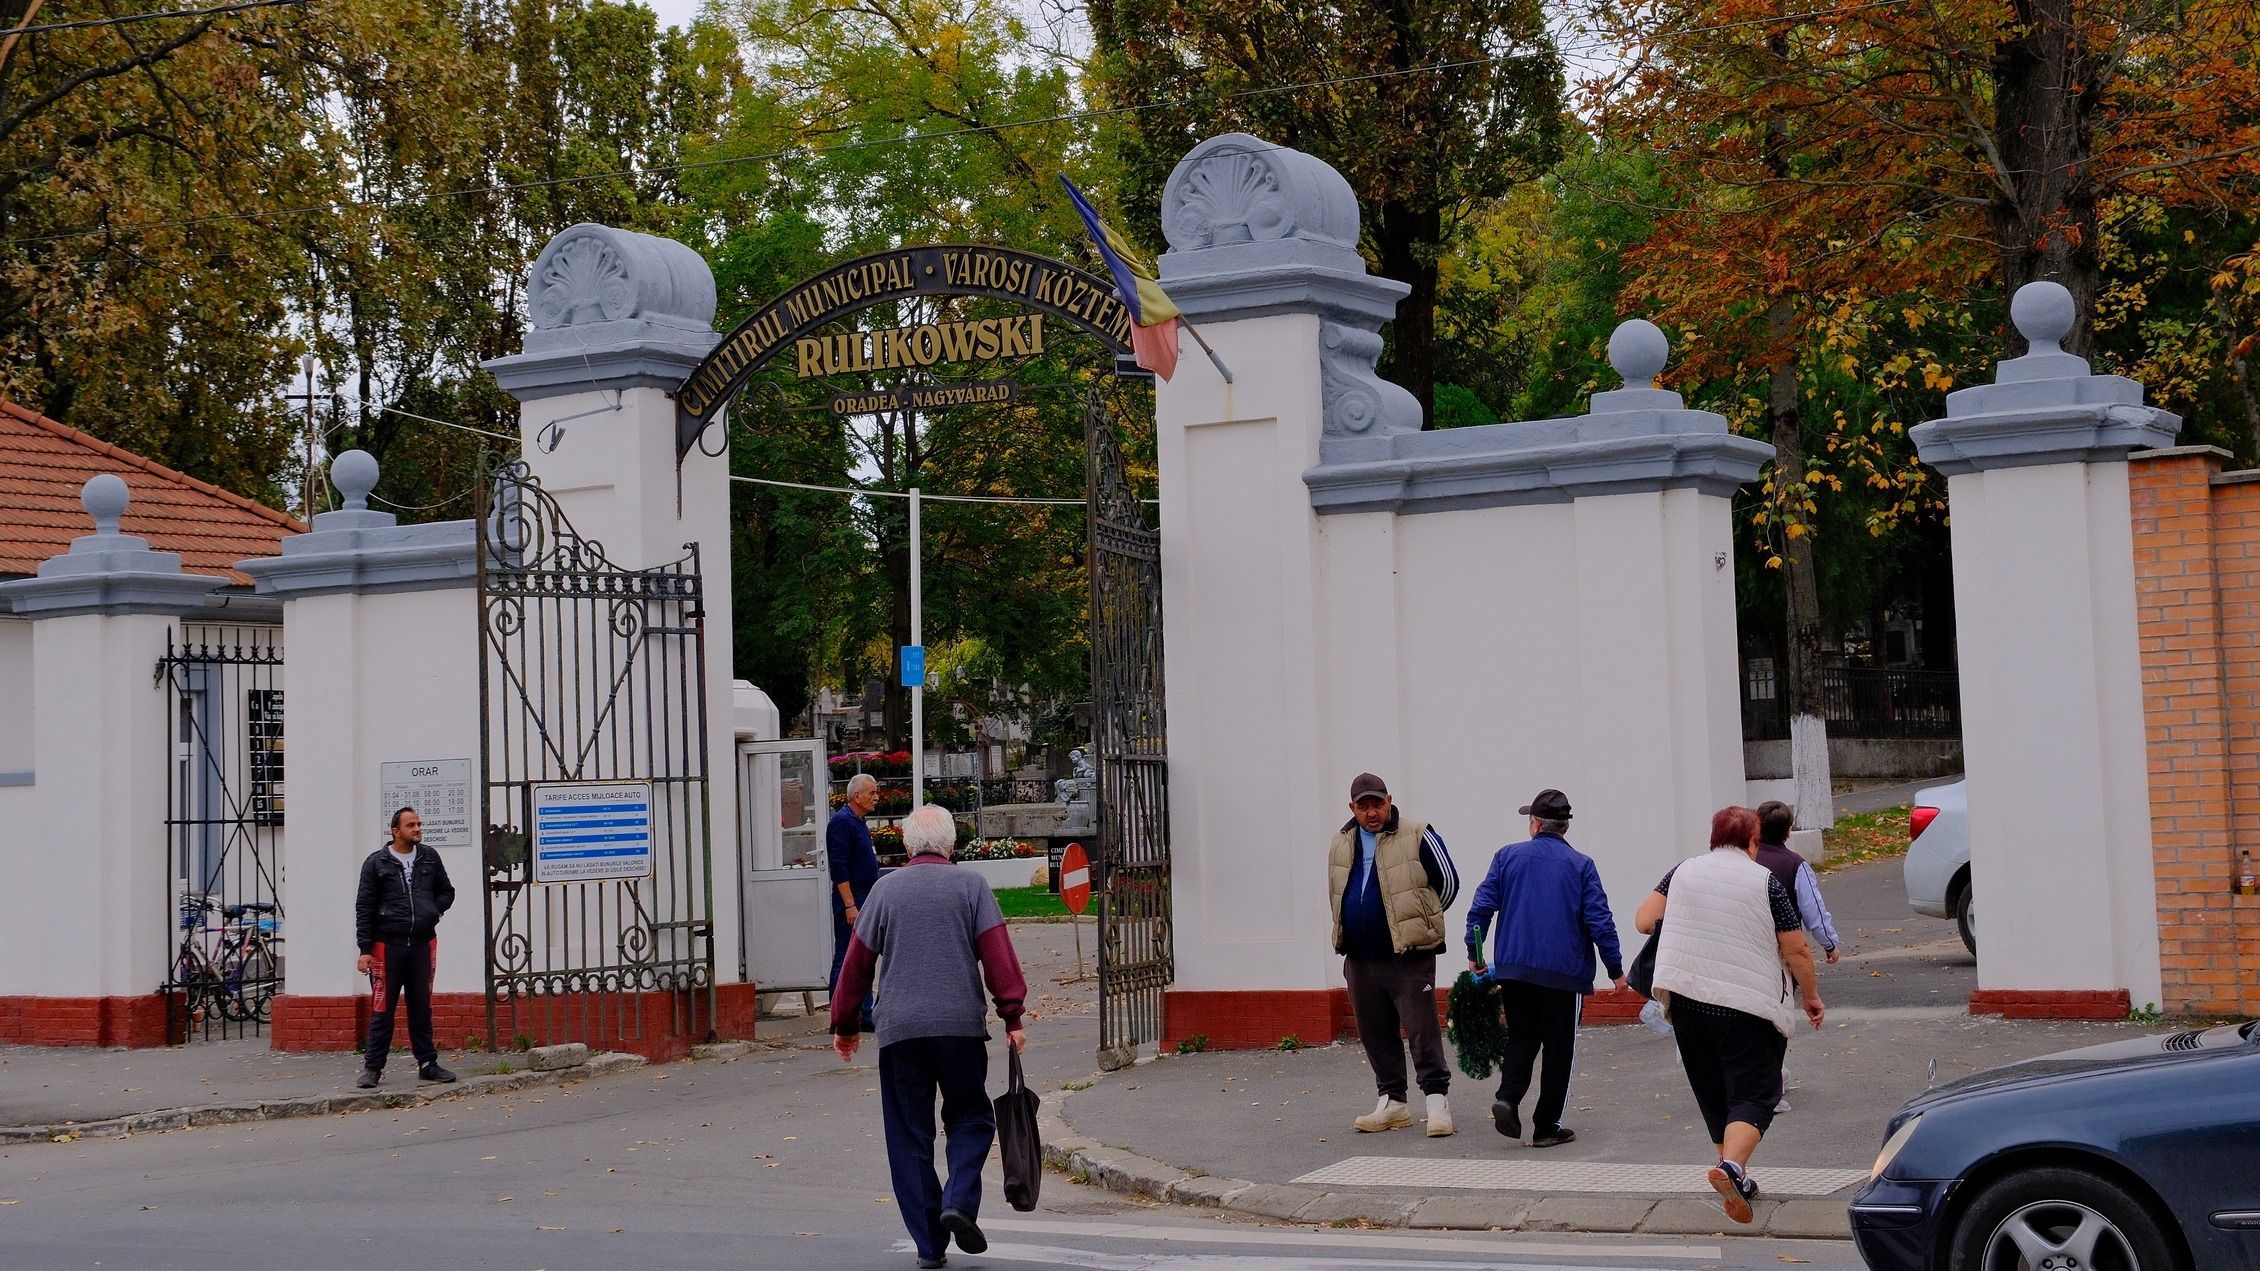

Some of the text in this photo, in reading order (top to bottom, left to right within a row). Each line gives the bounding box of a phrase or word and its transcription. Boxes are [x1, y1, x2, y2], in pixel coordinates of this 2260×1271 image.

[682, 248, 1132, 417] CIMITIRUL MUNICIPAL VÁROSI KÖZTEM
[797, 313, 1045, 378] RULIKOWSKI
[834, 394, 900, 415] ORADEA
[912, 381, 1010, 408] NAGYVÁRAD
[411, 766, 439, 777] ORAR
[545, 791, 641, 801] TARIFE ACCES MIJLOACE AUTO
